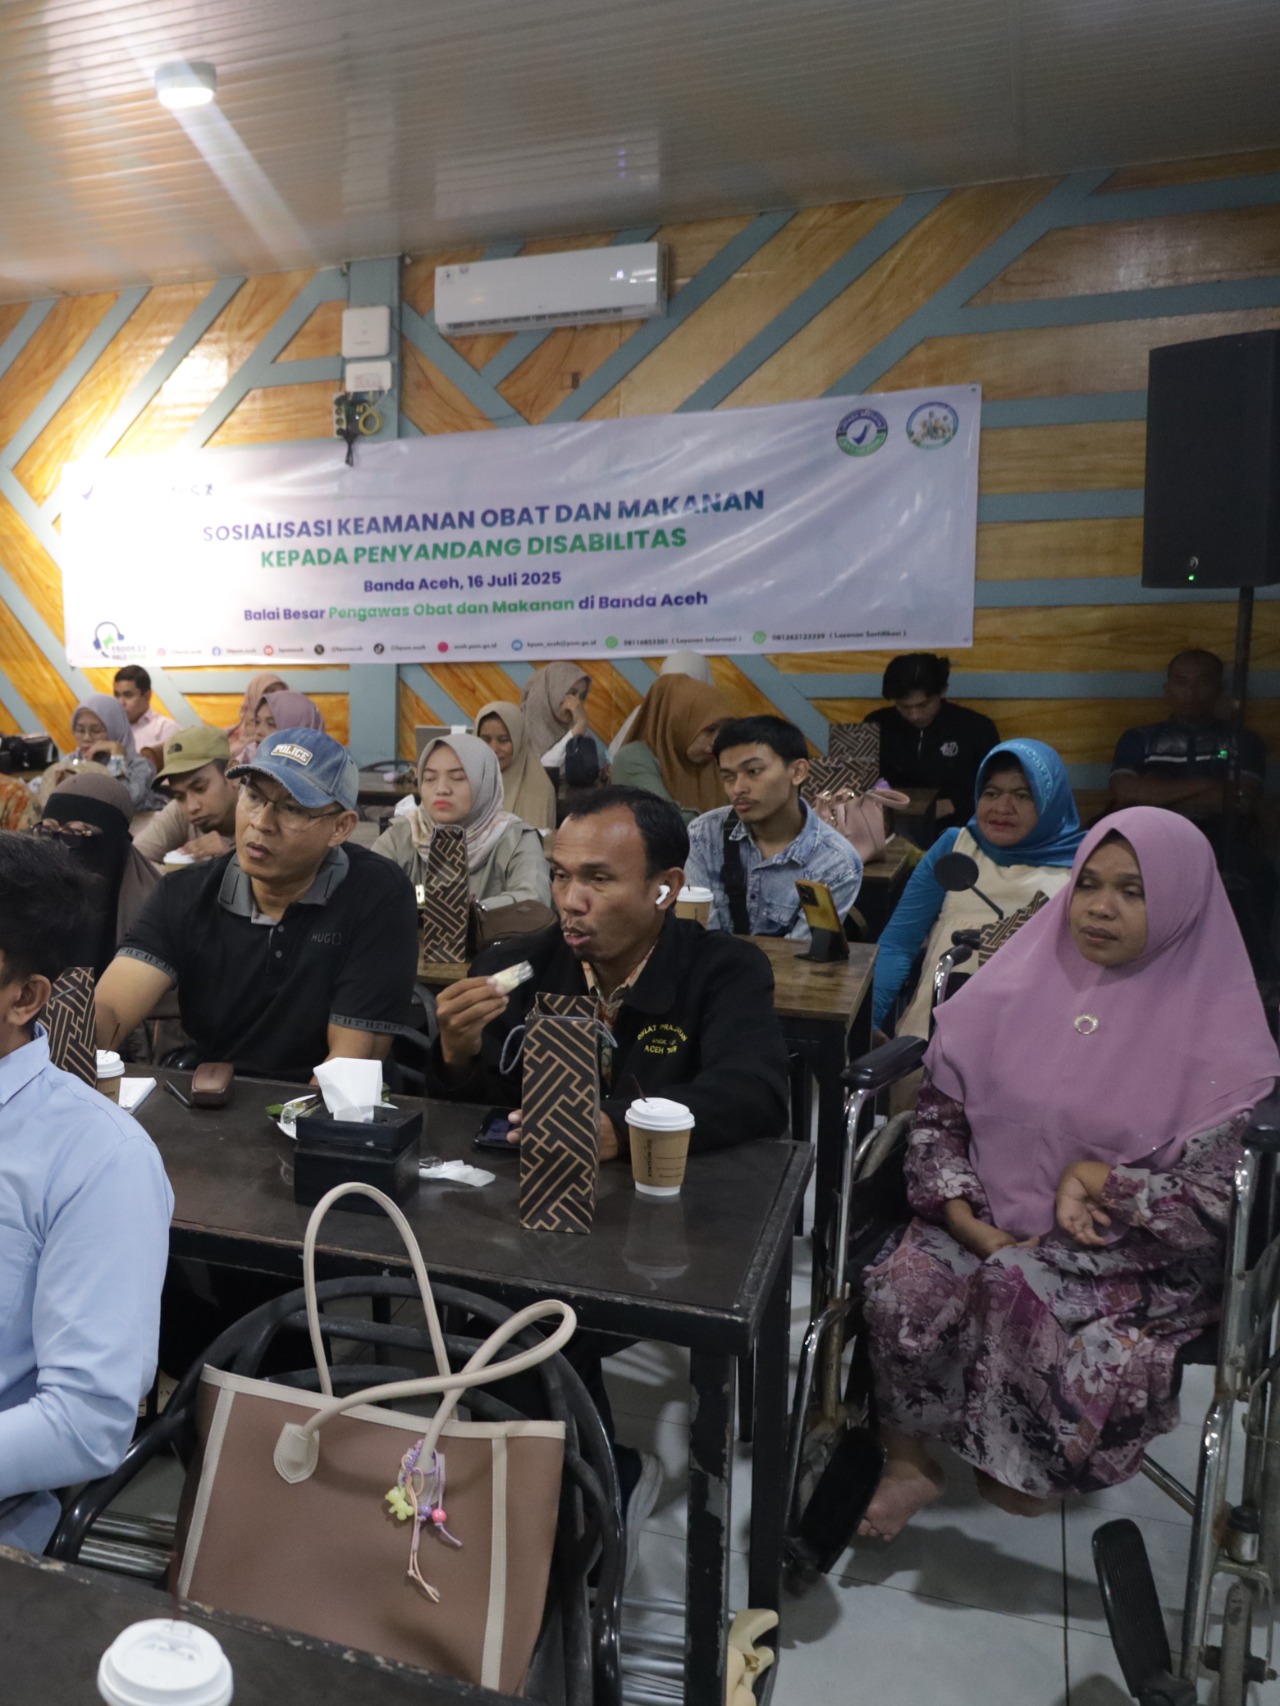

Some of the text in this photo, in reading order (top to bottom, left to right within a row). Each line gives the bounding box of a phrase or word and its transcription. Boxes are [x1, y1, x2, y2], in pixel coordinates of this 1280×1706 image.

[203, 489, 766, 541] SOSIALISASI KEAMANAN OBAT DAN MAKANAN
[261, 528, 687, 568] KEPADA PENYANDANG DISABILITAS
[364, 571, 562, 592] Banda Aceh, 16 Juli 2025
[244, 592, 708, 621] Balai Besar Pengawas Obat dan Makanan di Banda Aceh
[273, 743, 310, 761] POLICE
[644, 1044, 664, 1054] ACEH
